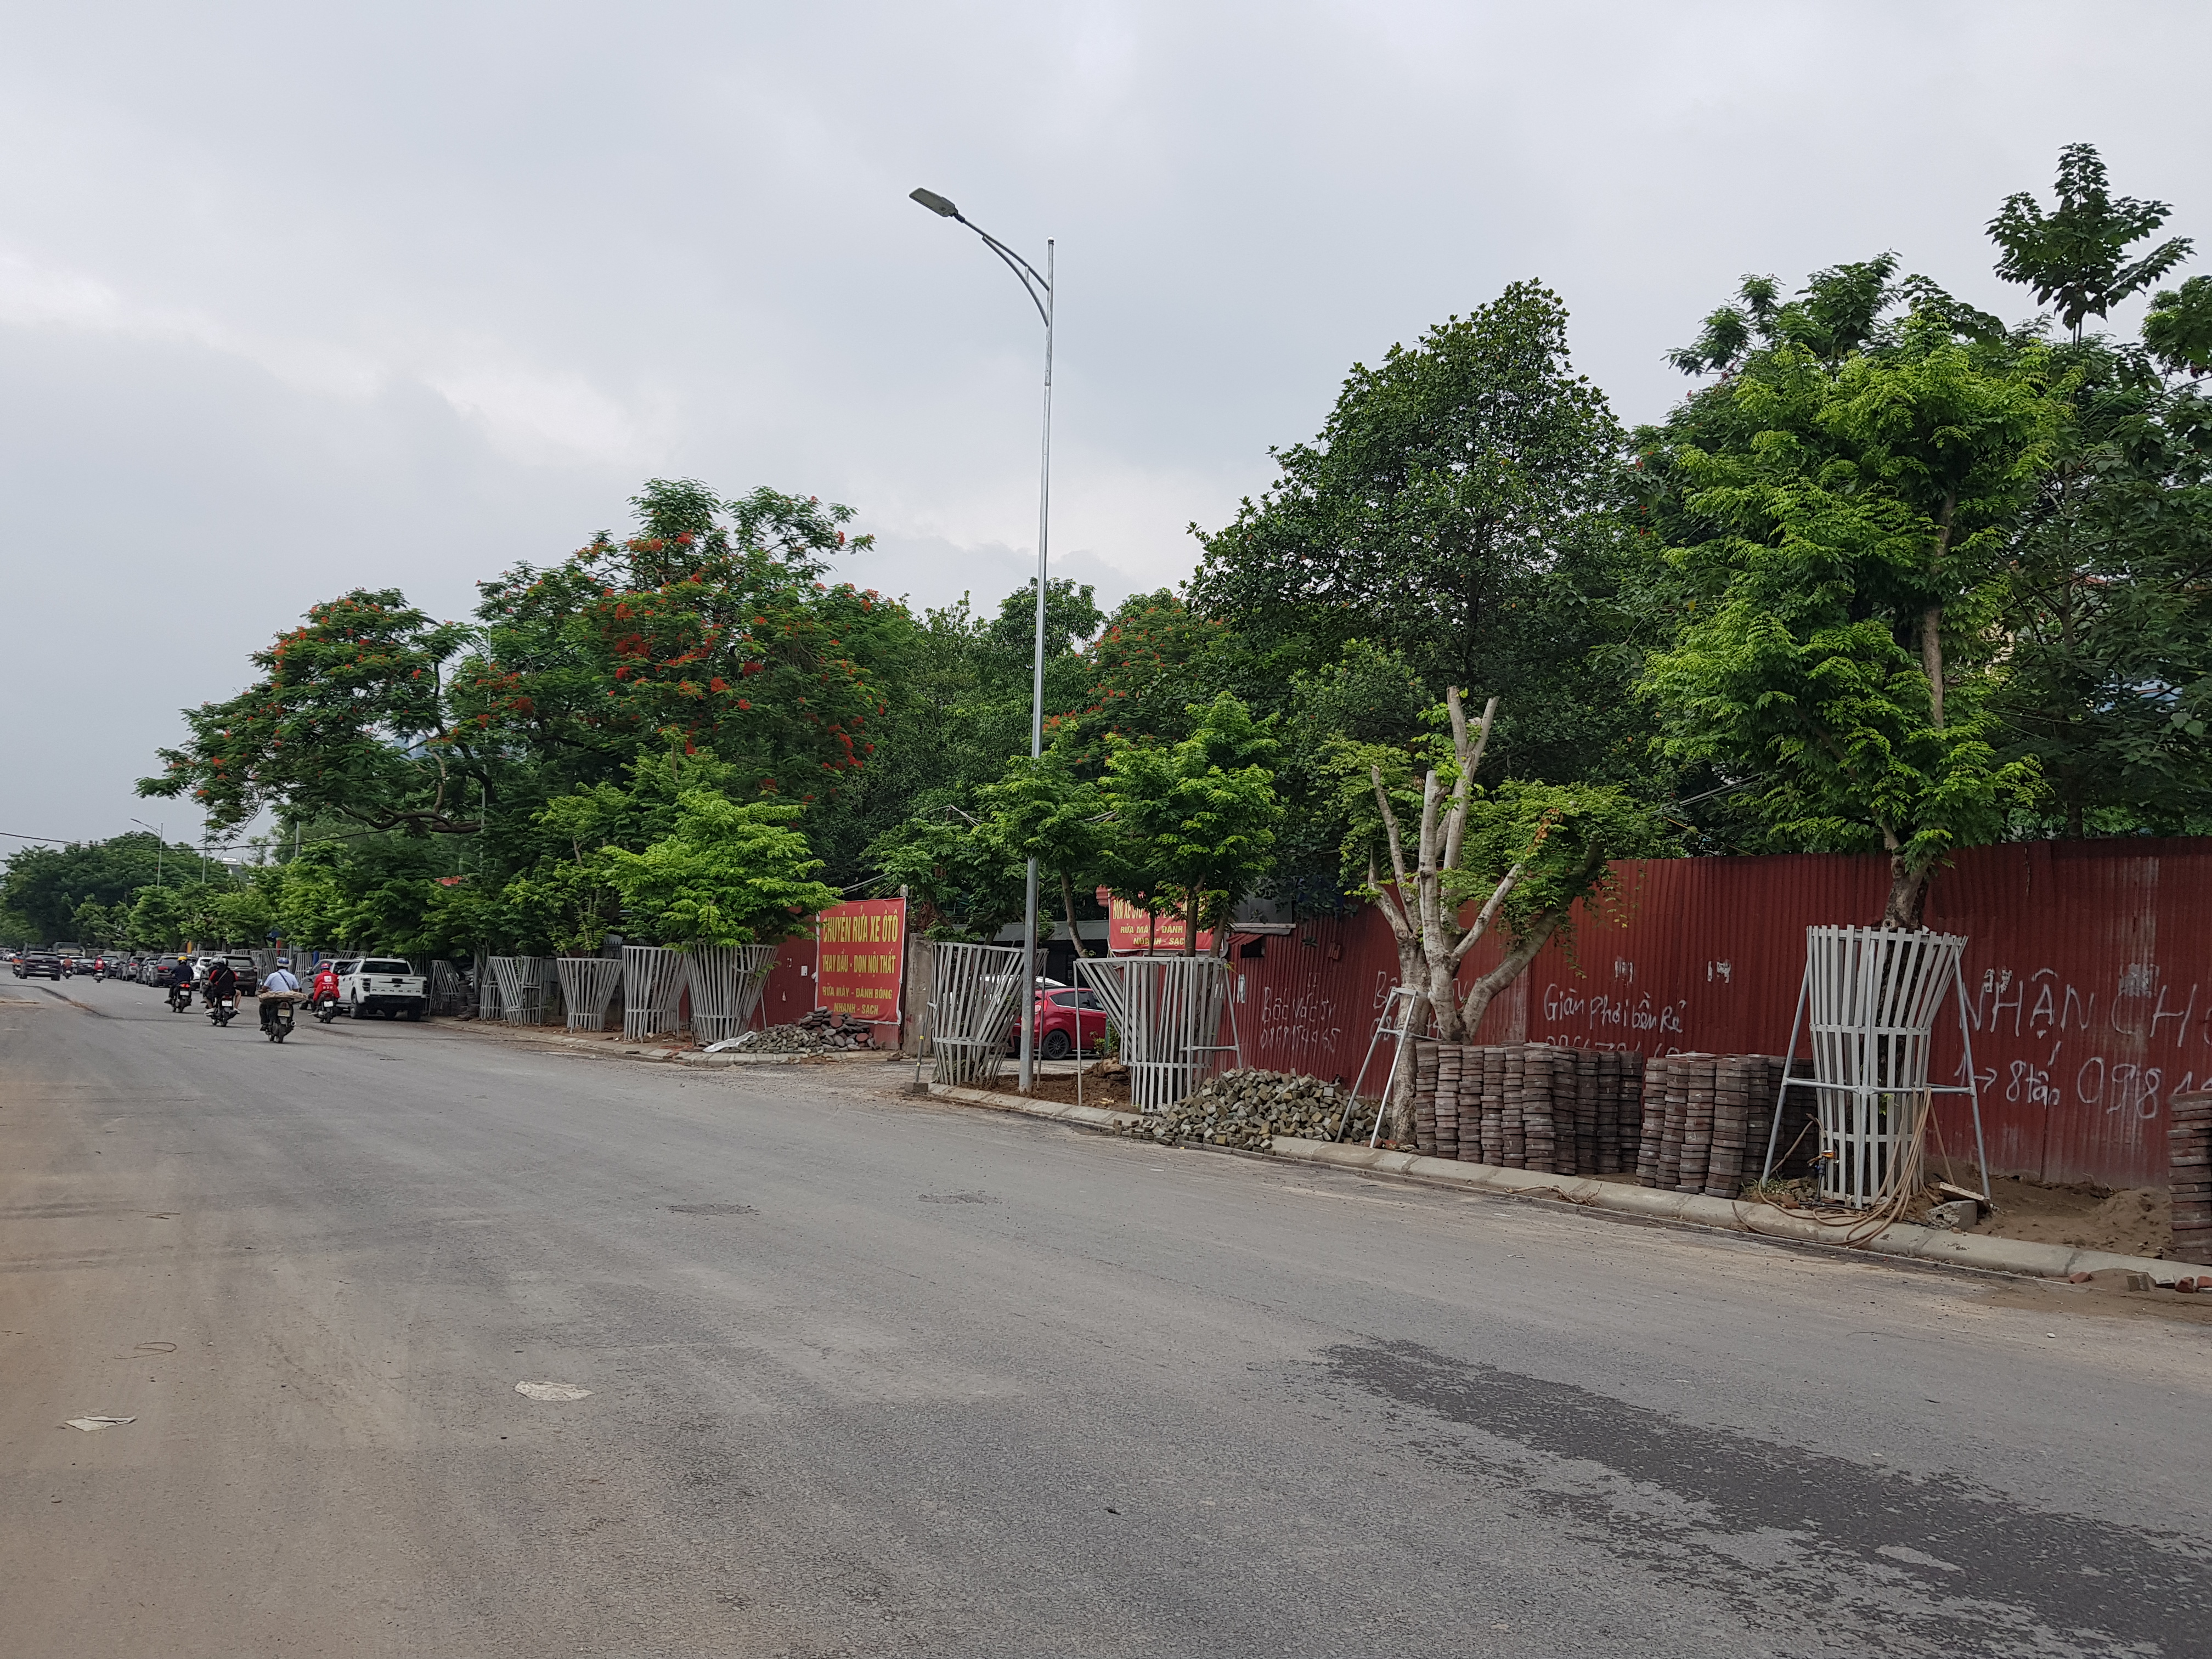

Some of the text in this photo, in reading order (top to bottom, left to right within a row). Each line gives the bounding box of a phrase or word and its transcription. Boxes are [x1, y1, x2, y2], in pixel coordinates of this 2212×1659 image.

[823, 904, 898, 943] CHUYÊN RỬA XE ÔTÔ
[1120, 923, 1135, 933] RỬA
[1161, 924, 1183, 933] ĐÁNH
[1169, 937, 1185, 947] SẠC
[822, 955, 836, 972] THAY
[854, 955, 867, 977] DỌN
[868, 951, 879, 978] NỘI
[879, 948, 896, 974] THẤT
[822, 982, 834, 996] RỬA
[836, 985, 850, 997] MÁY
[855, 986, 873, 998] ĐÁNH
[874, 986, 893, 1000] BÓNG
[834, 1002, 856, 1013] NHANH
[861, 1004, 879, 1017] SẠCH
[1959, 968, 2095, 1039] NHẬN
